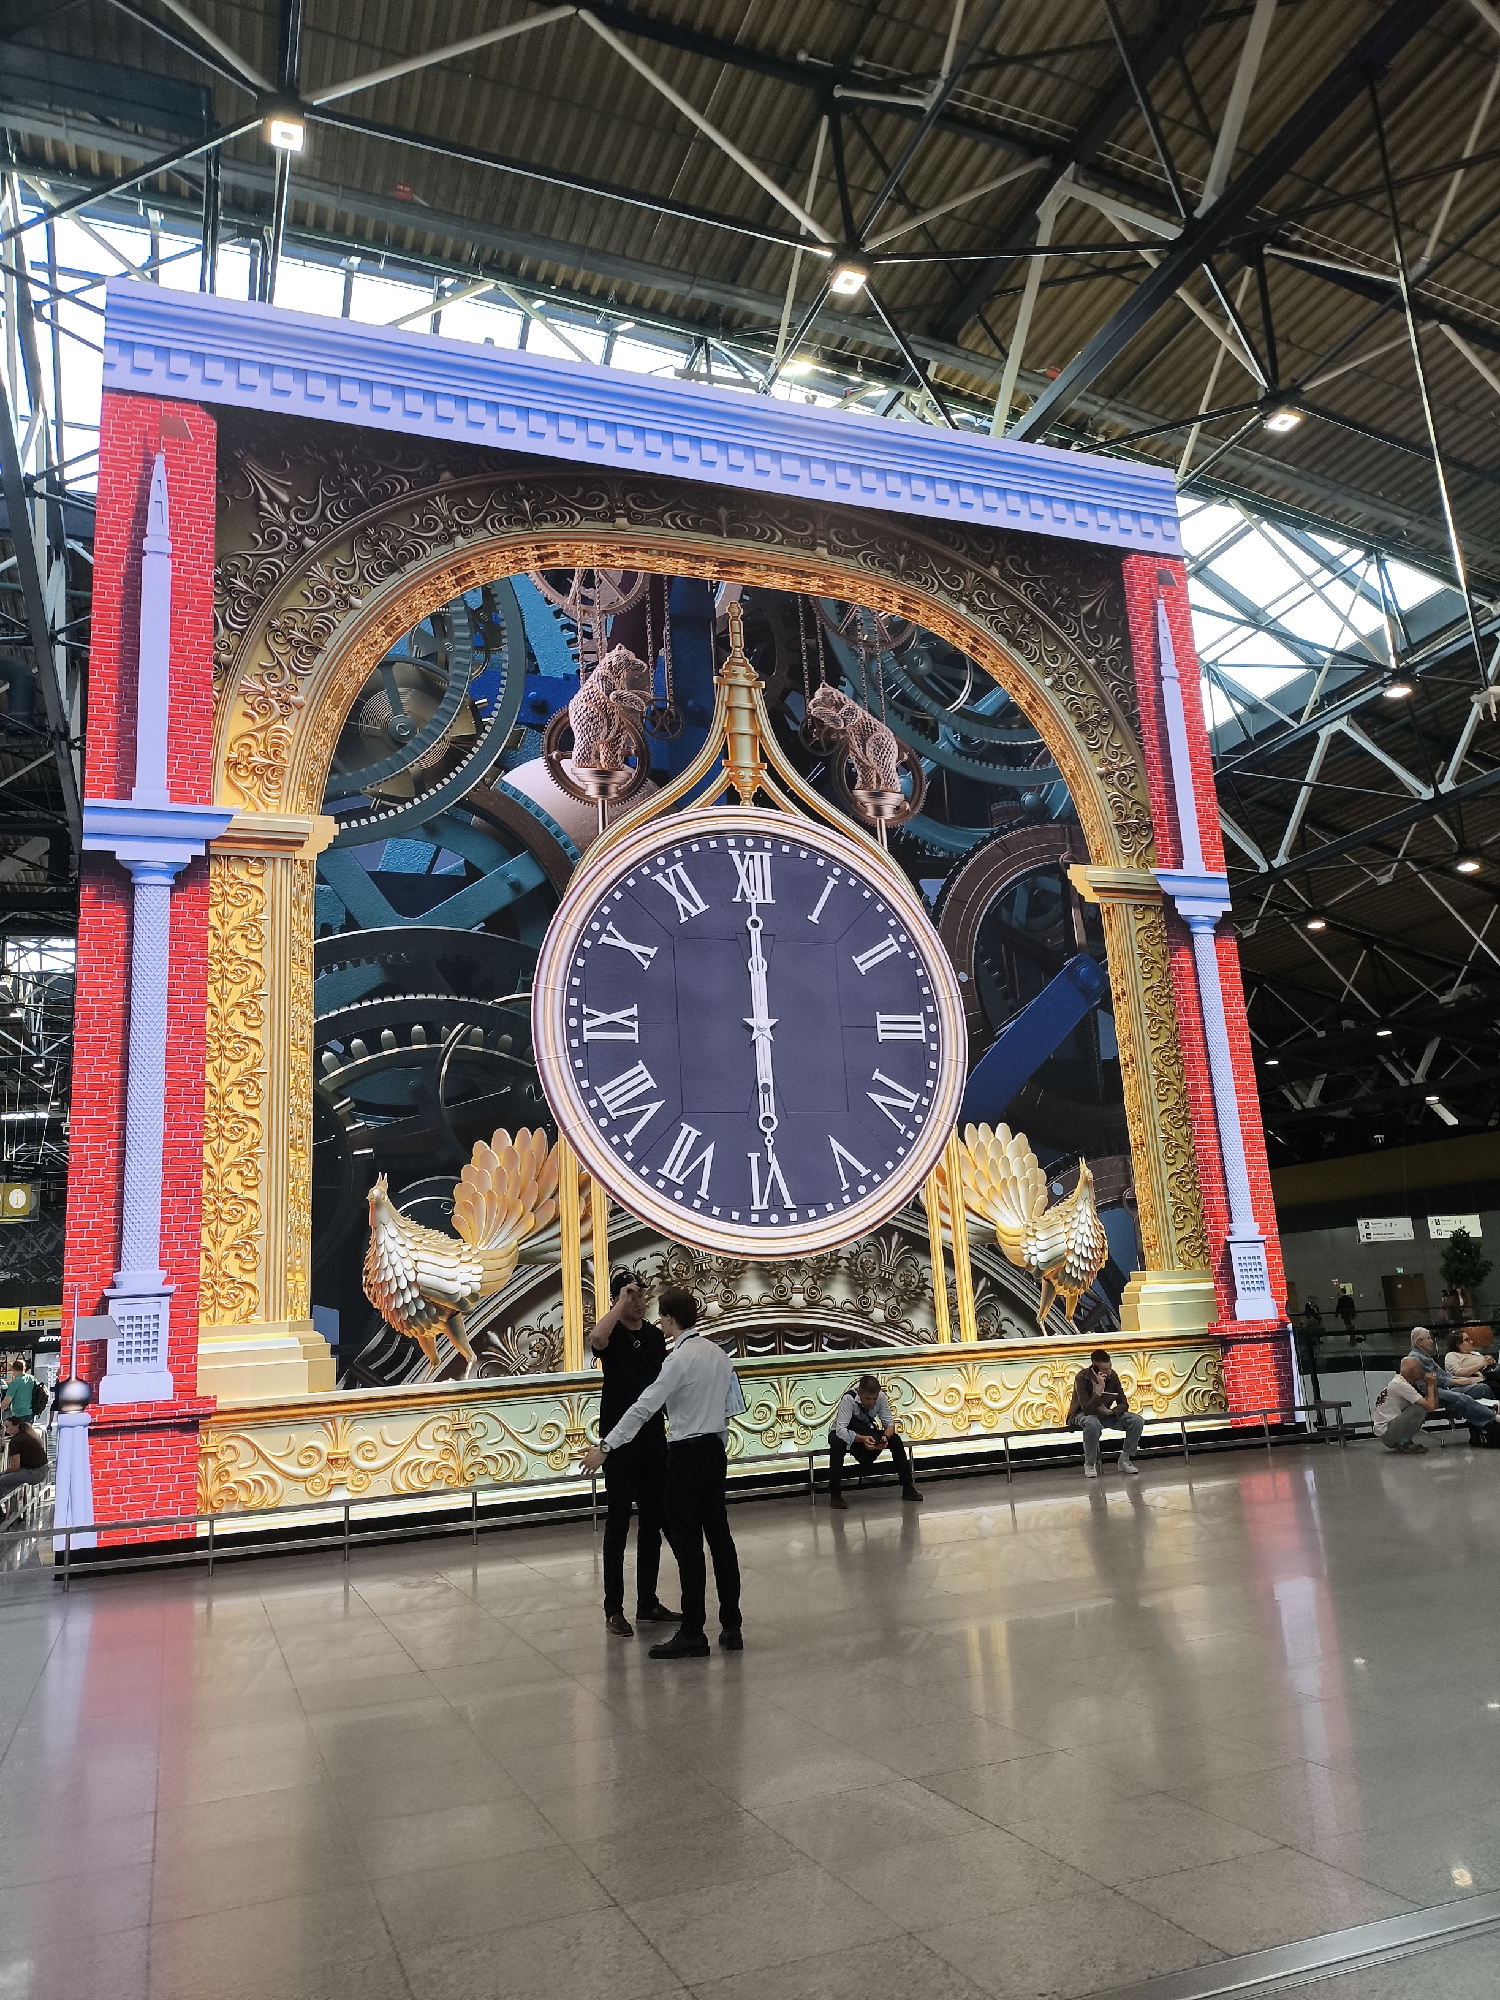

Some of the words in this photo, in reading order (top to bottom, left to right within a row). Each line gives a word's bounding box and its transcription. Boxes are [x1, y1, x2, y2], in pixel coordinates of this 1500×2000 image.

[652, 862, 710, 923] XI
[807, 875, 838, 924] I
[598, 922, 658, 970] X
[852, 934, 901, 975] II
[582, 1004, 639, 1043] IX
[876, 1012, 926, 1042] III
[595, 1060, 666, 1146] VIII
[866, 1069, 920, 1134] IV
[657, 1123, 715, 1200] VII
[748, 1153, 796, 1209] VI
[828, 1135, 870, 1191] V
